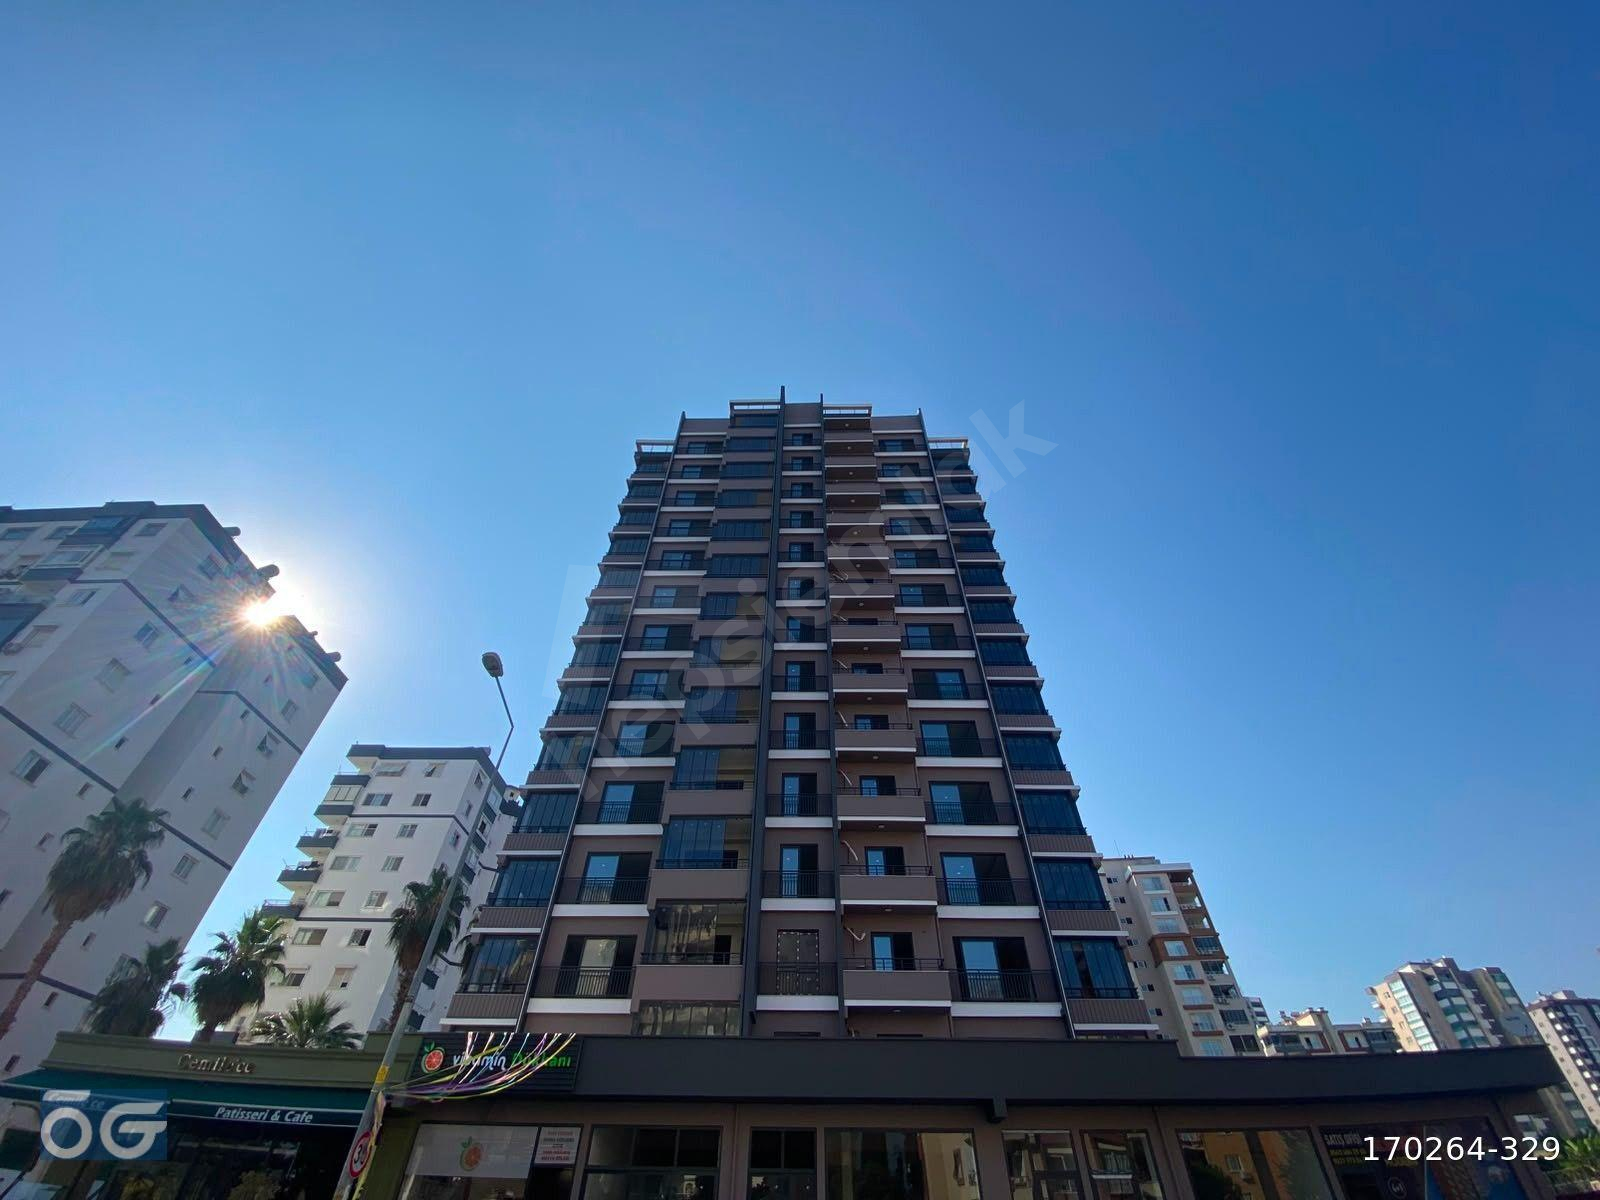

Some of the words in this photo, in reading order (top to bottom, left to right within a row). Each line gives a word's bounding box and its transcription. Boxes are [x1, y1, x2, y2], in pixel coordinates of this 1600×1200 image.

[214, 1105, 268, 1121] Patisseri
[270, 1109, 281, 1121] &
[284, 1111, 314, 1123] Cafe
